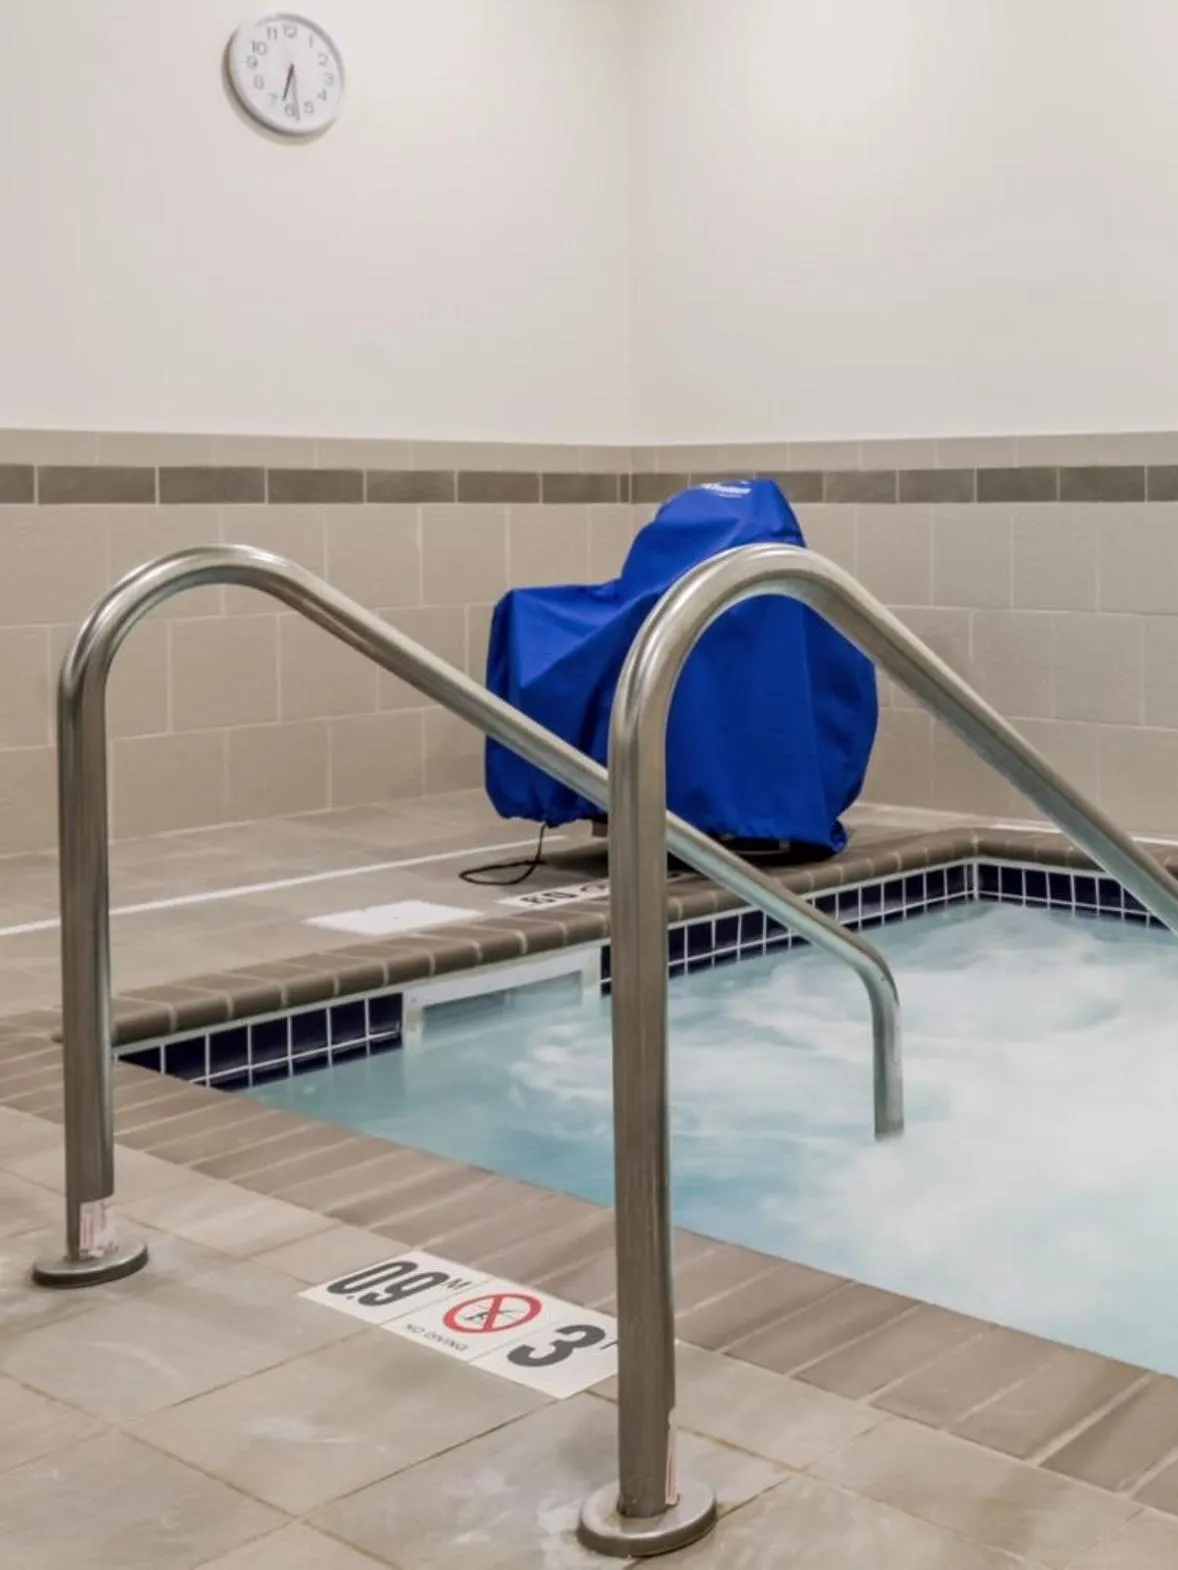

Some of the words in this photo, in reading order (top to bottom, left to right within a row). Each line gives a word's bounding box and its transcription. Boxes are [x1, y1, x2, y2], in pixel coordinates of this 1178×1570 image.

[266, 27, 278, 41] 11
[282, 24, 297, 38] 12
[252, 40, 268, 55] 10
[309, 35, 313, 48] 1
[247, 55, 259, 70] 9
[317, 52, 329, 66] 2
[268, 92, 279, 107] 7
[316, 89, 327, 101] 4
[327, 1260, 450, 1307] 0.9
[405, 1323, 426, 1335] NO
[507, 1324, 606, 1368] 3
